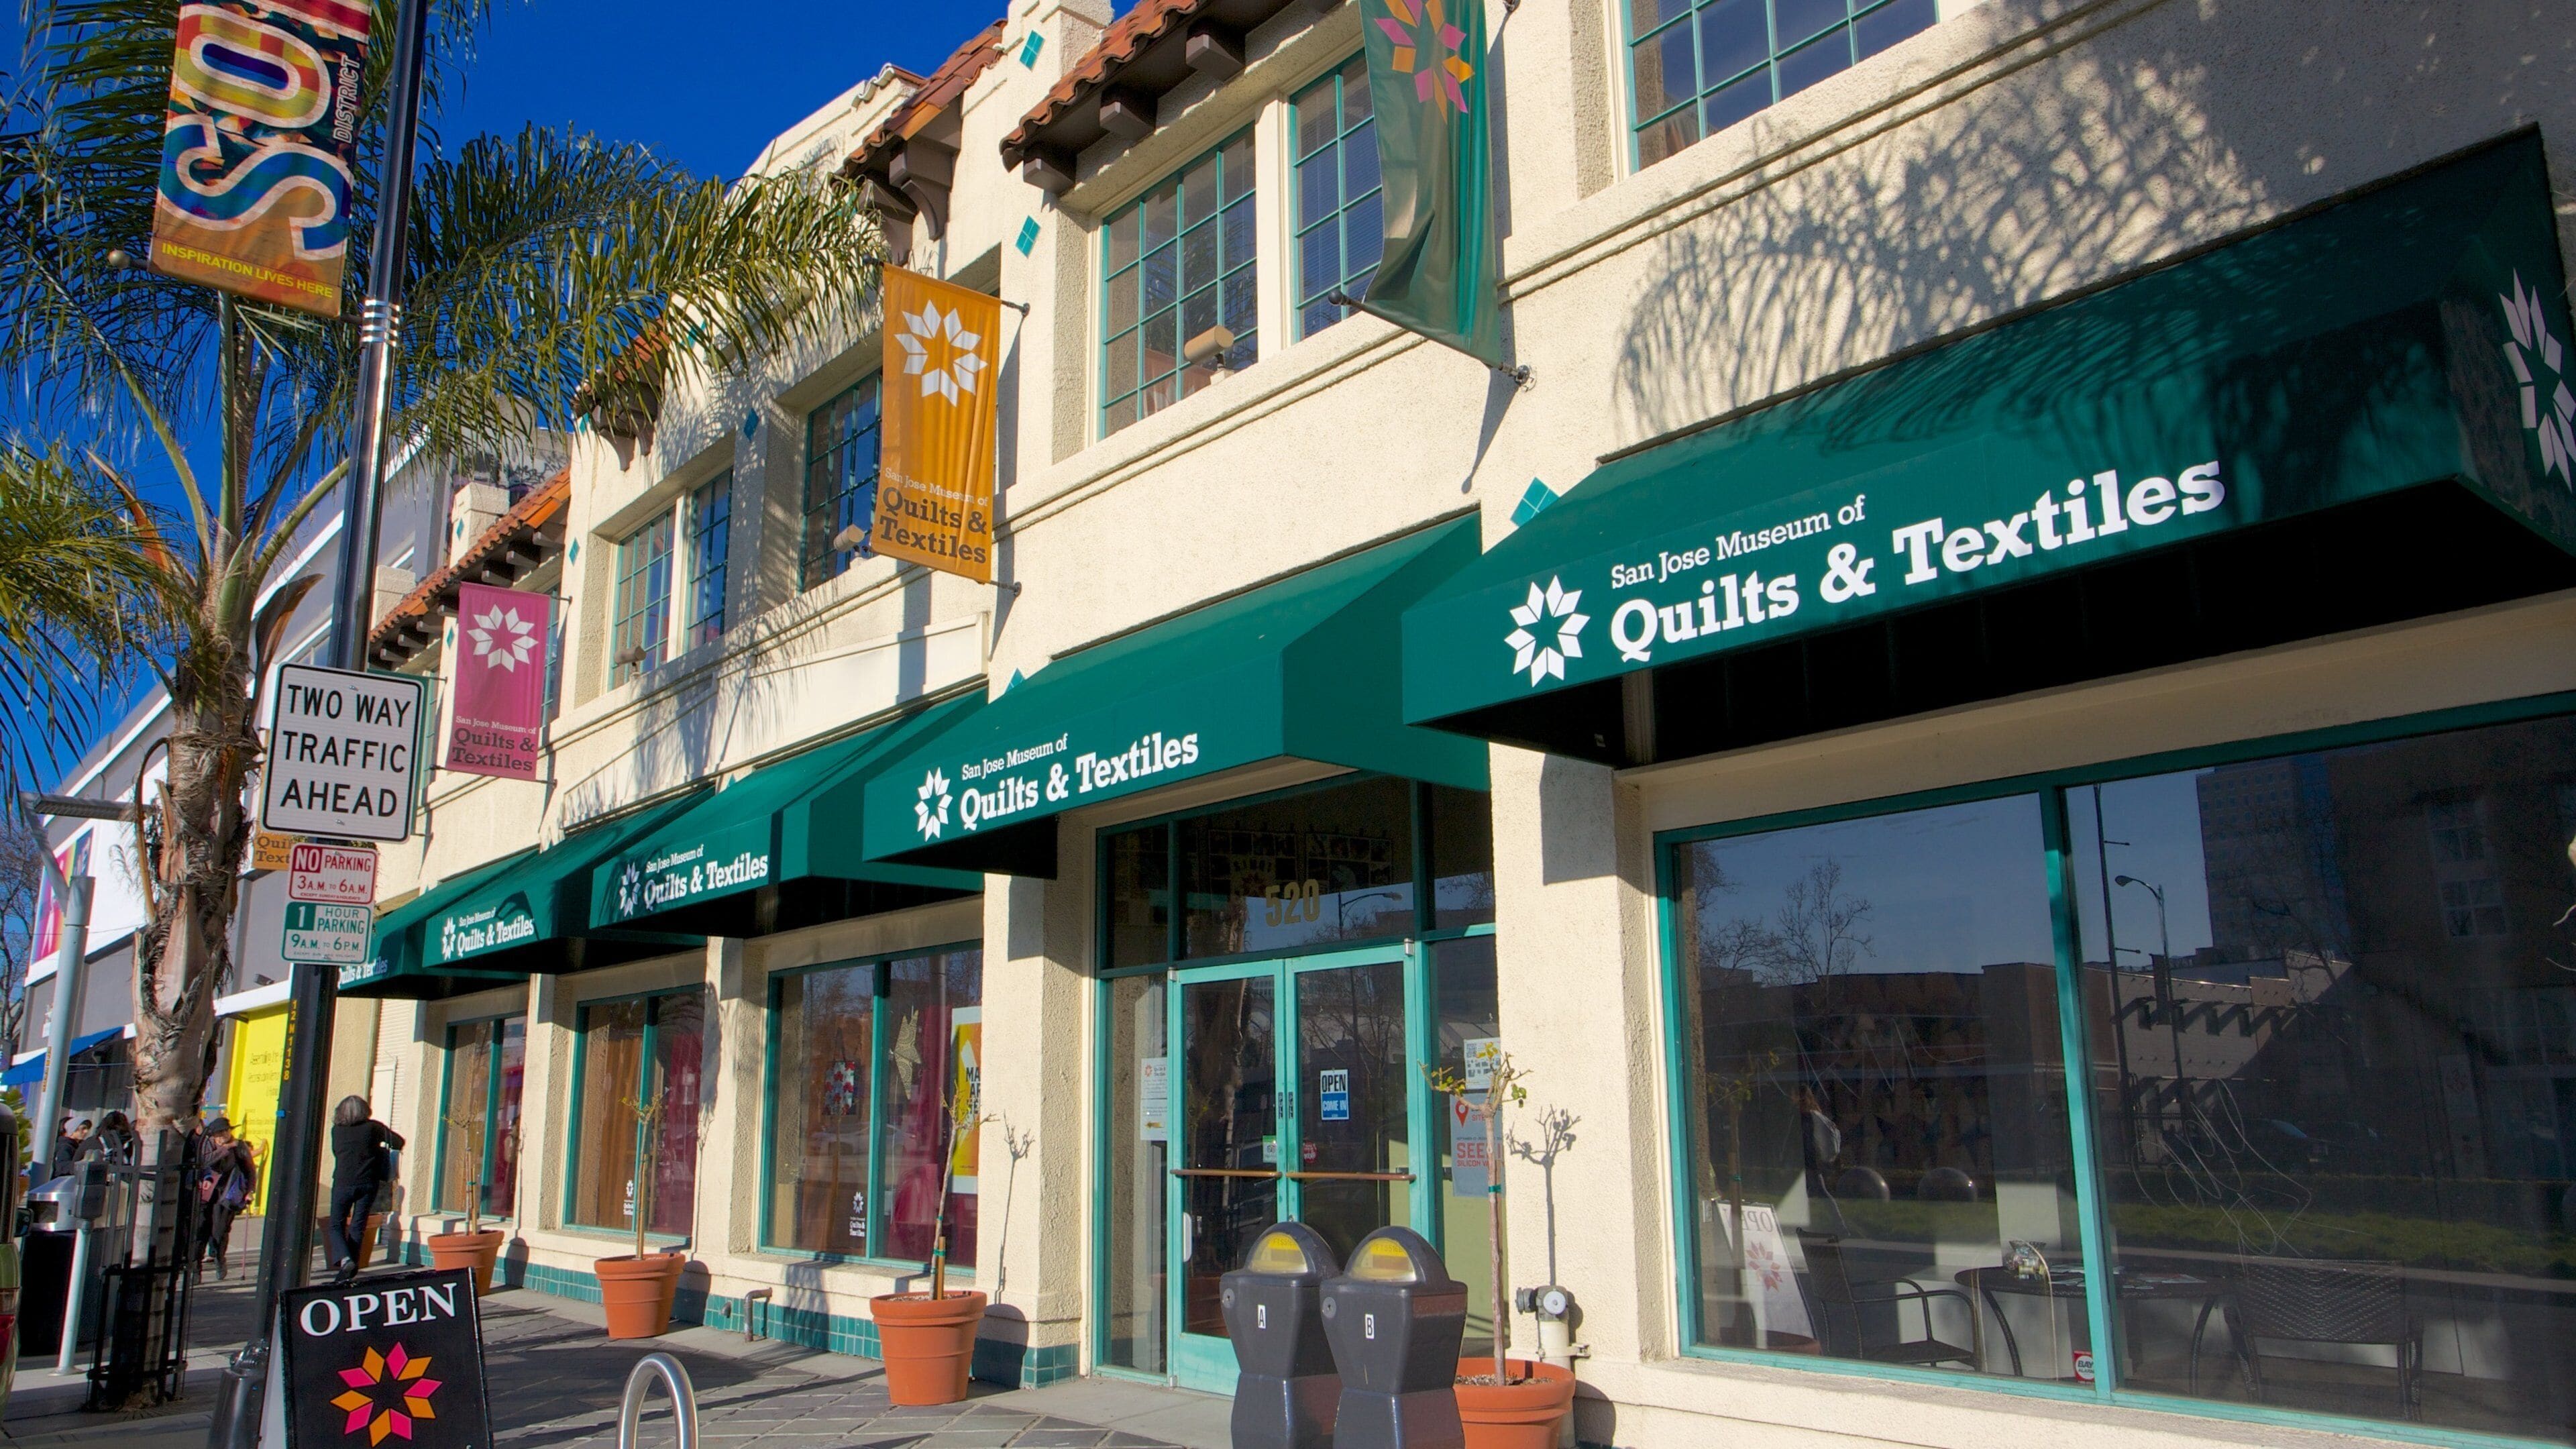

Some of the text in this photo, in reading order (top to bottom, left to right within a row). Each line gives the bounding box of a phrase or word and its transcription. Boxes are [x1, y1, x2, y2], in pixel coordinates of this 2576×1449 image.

[333, 55, 360, 144] DISTRICT
[162, 242, 333, 299] INSPIRATION LIVES HERE
[885, 467, 988, 506] San Jose Museum of
[882, 486, 987, 535] Quilts &
[879, 515, 986, 564] Textiles
[1611, 494, 1866, 589] San Jose Museum of
[1609, 460, 2226, 663] Quilts & Textiles
[288, 684, 411, 728] TWO WAY
[455, 715, 537, 735] San Jose Museum of
[282, 731, 407, 773] TRAFFIC
[451, 747, 533, 771] Textiles
[454, 727, 535, 753] Quilts &
[962, 733, 1068, 780] San Jose Museum of
[280, 779, 397, 817] AHEAD
[960, 731, 1199, 831] Quilts & Textiles
[256, 836, 292, 850] Quil
[256, 850, 290, 863] Text
[294, 849, 371, 872] NO PARKING
[646, 844, 704, 873] San Jose Museum of
[644, 852, 768, 911] Quilts & Textiles
[299, 906, 359, 928] 1 HOUR
[466, 915, 474, 928] Jose
[474, 912, 491, 923] Museum
[491, 906, 496, 918] of
[1265, 879, 1320, 927] 520
[317, 918, 364, 934] PARKING
[458, 914, 535, 957] Quilts & Textiles
[1322, 1074, 1346, 1093] OPEN
[1322, 1099, 1347, 1111] COME IN
[300, 1283, 458, 1336] OPEN
[1258, 1308, 1265, 1326] A
[1366, 1317, 1373, 1336] B
[2078, 1360, 2094, 1368] BAY
